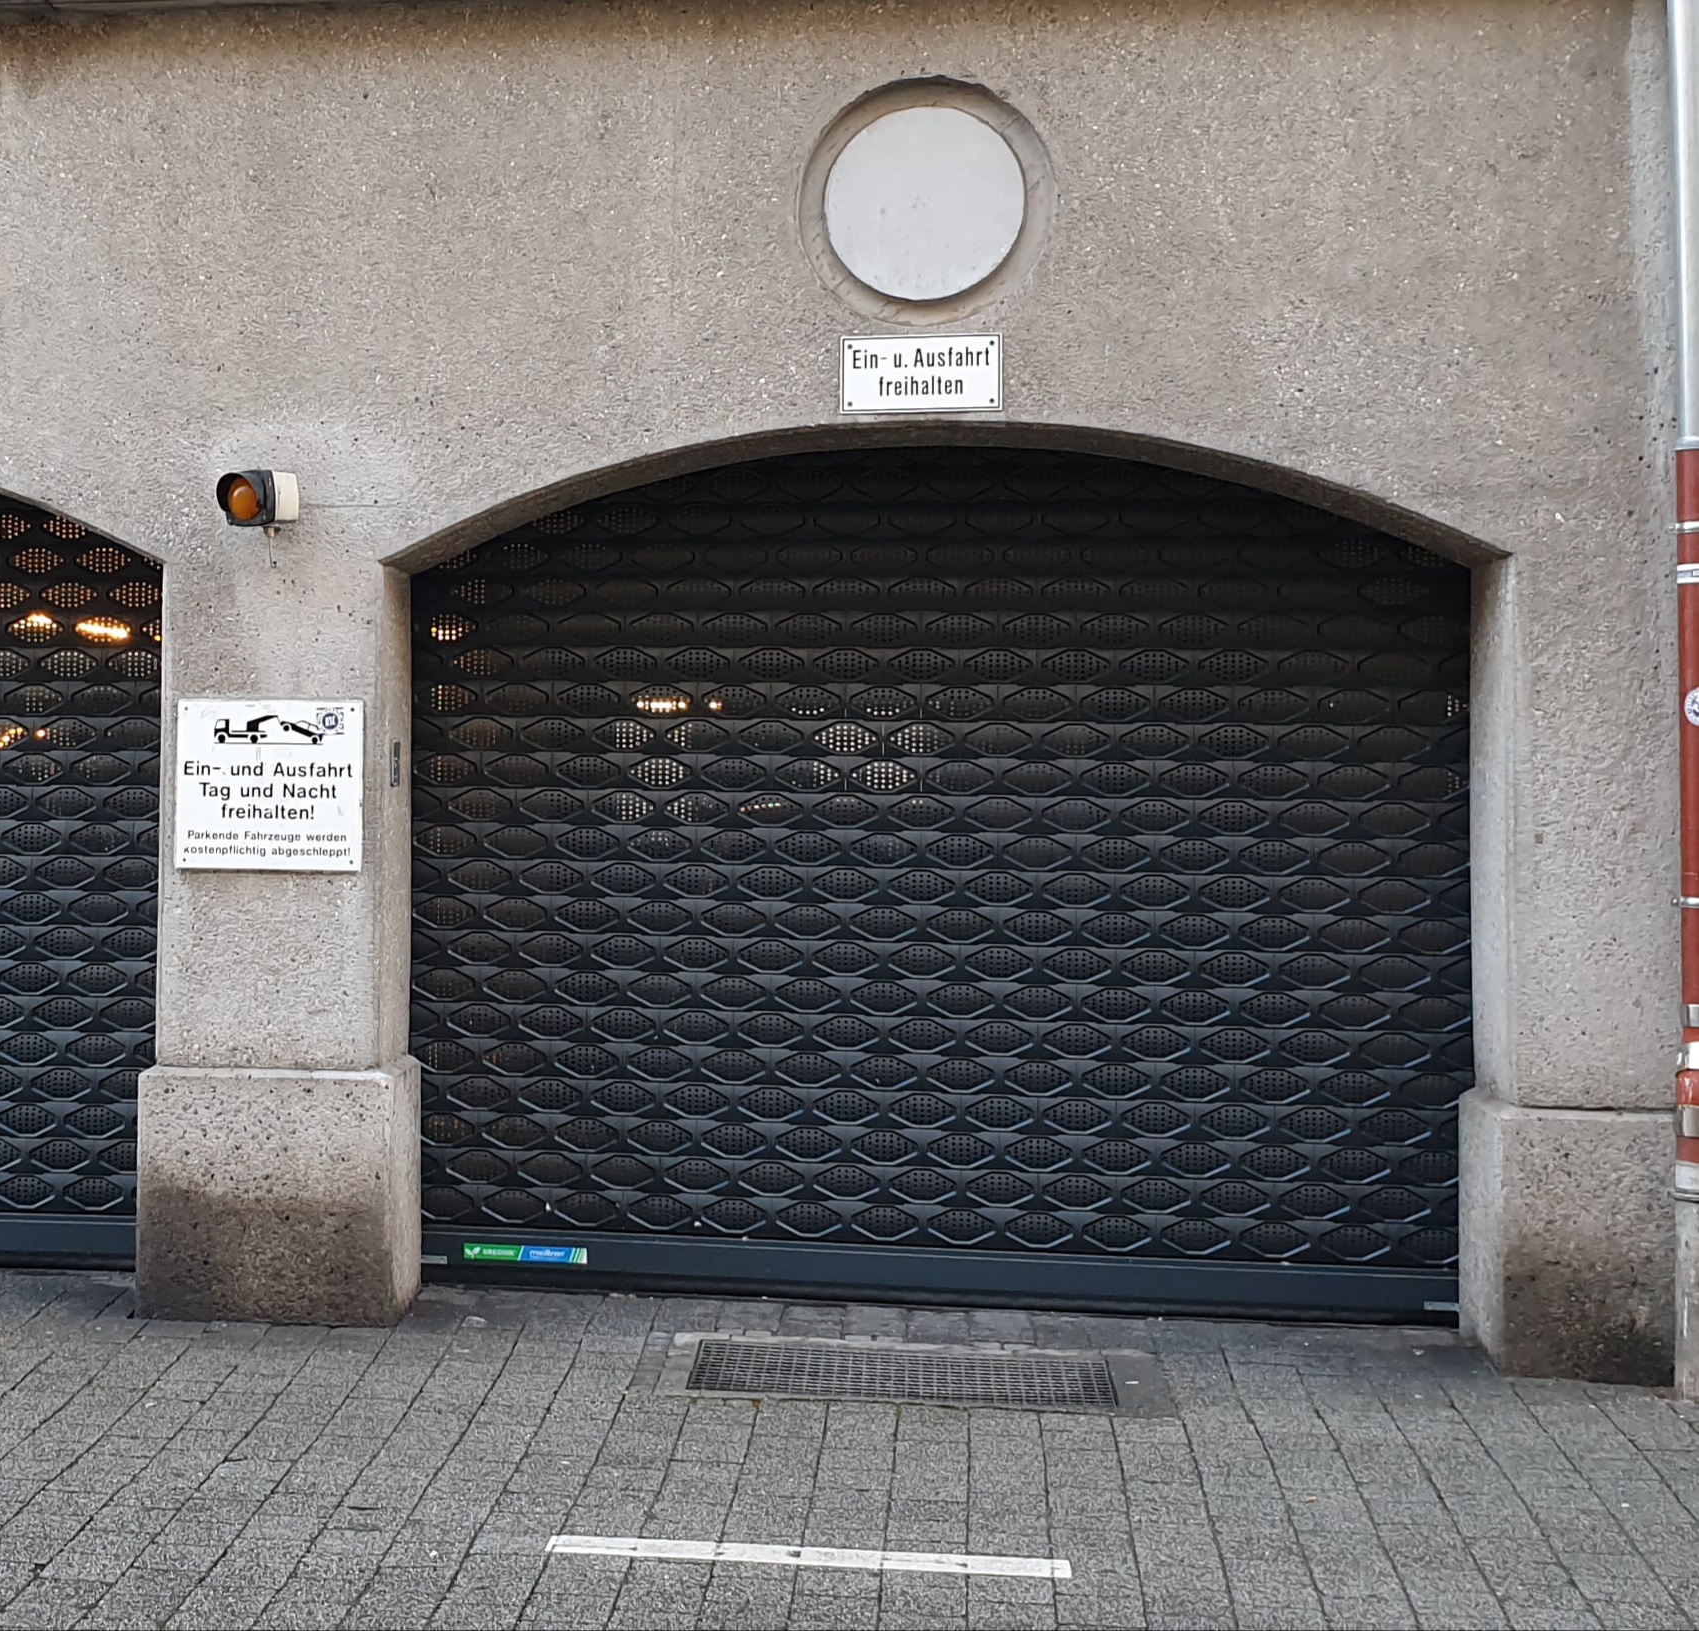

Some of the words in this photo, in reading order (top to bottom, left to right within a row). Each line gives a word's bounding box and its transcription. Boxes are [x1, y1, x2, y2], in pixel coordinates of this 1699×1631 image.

[852, 349, 887, 369] Ein-
[893, 353, 908, 368] u.
[913, 346, 990, 367] Ausfahrt
[879, 375, 963, 396] freihalten
[183, 760, 221, 776] Ein-
[230, 762, 264, 776] und
[273, 762, 353, 778] Ausfahrt
[199, 782, 231, 800] Tag
[240, 783, 274, 798] und
[283, 783, 337, 799] Nacht
[221, 803, 315, 820] freihalten!
[187, 830, 239, 840] Parkende
[244, 831, 301, 843] Fahrzeuge
[306, 832, 347, 842] werden
[184, 845, 266, 857] kostenpflichtig
[271, 846, 350, 858] abgeschleppt!
